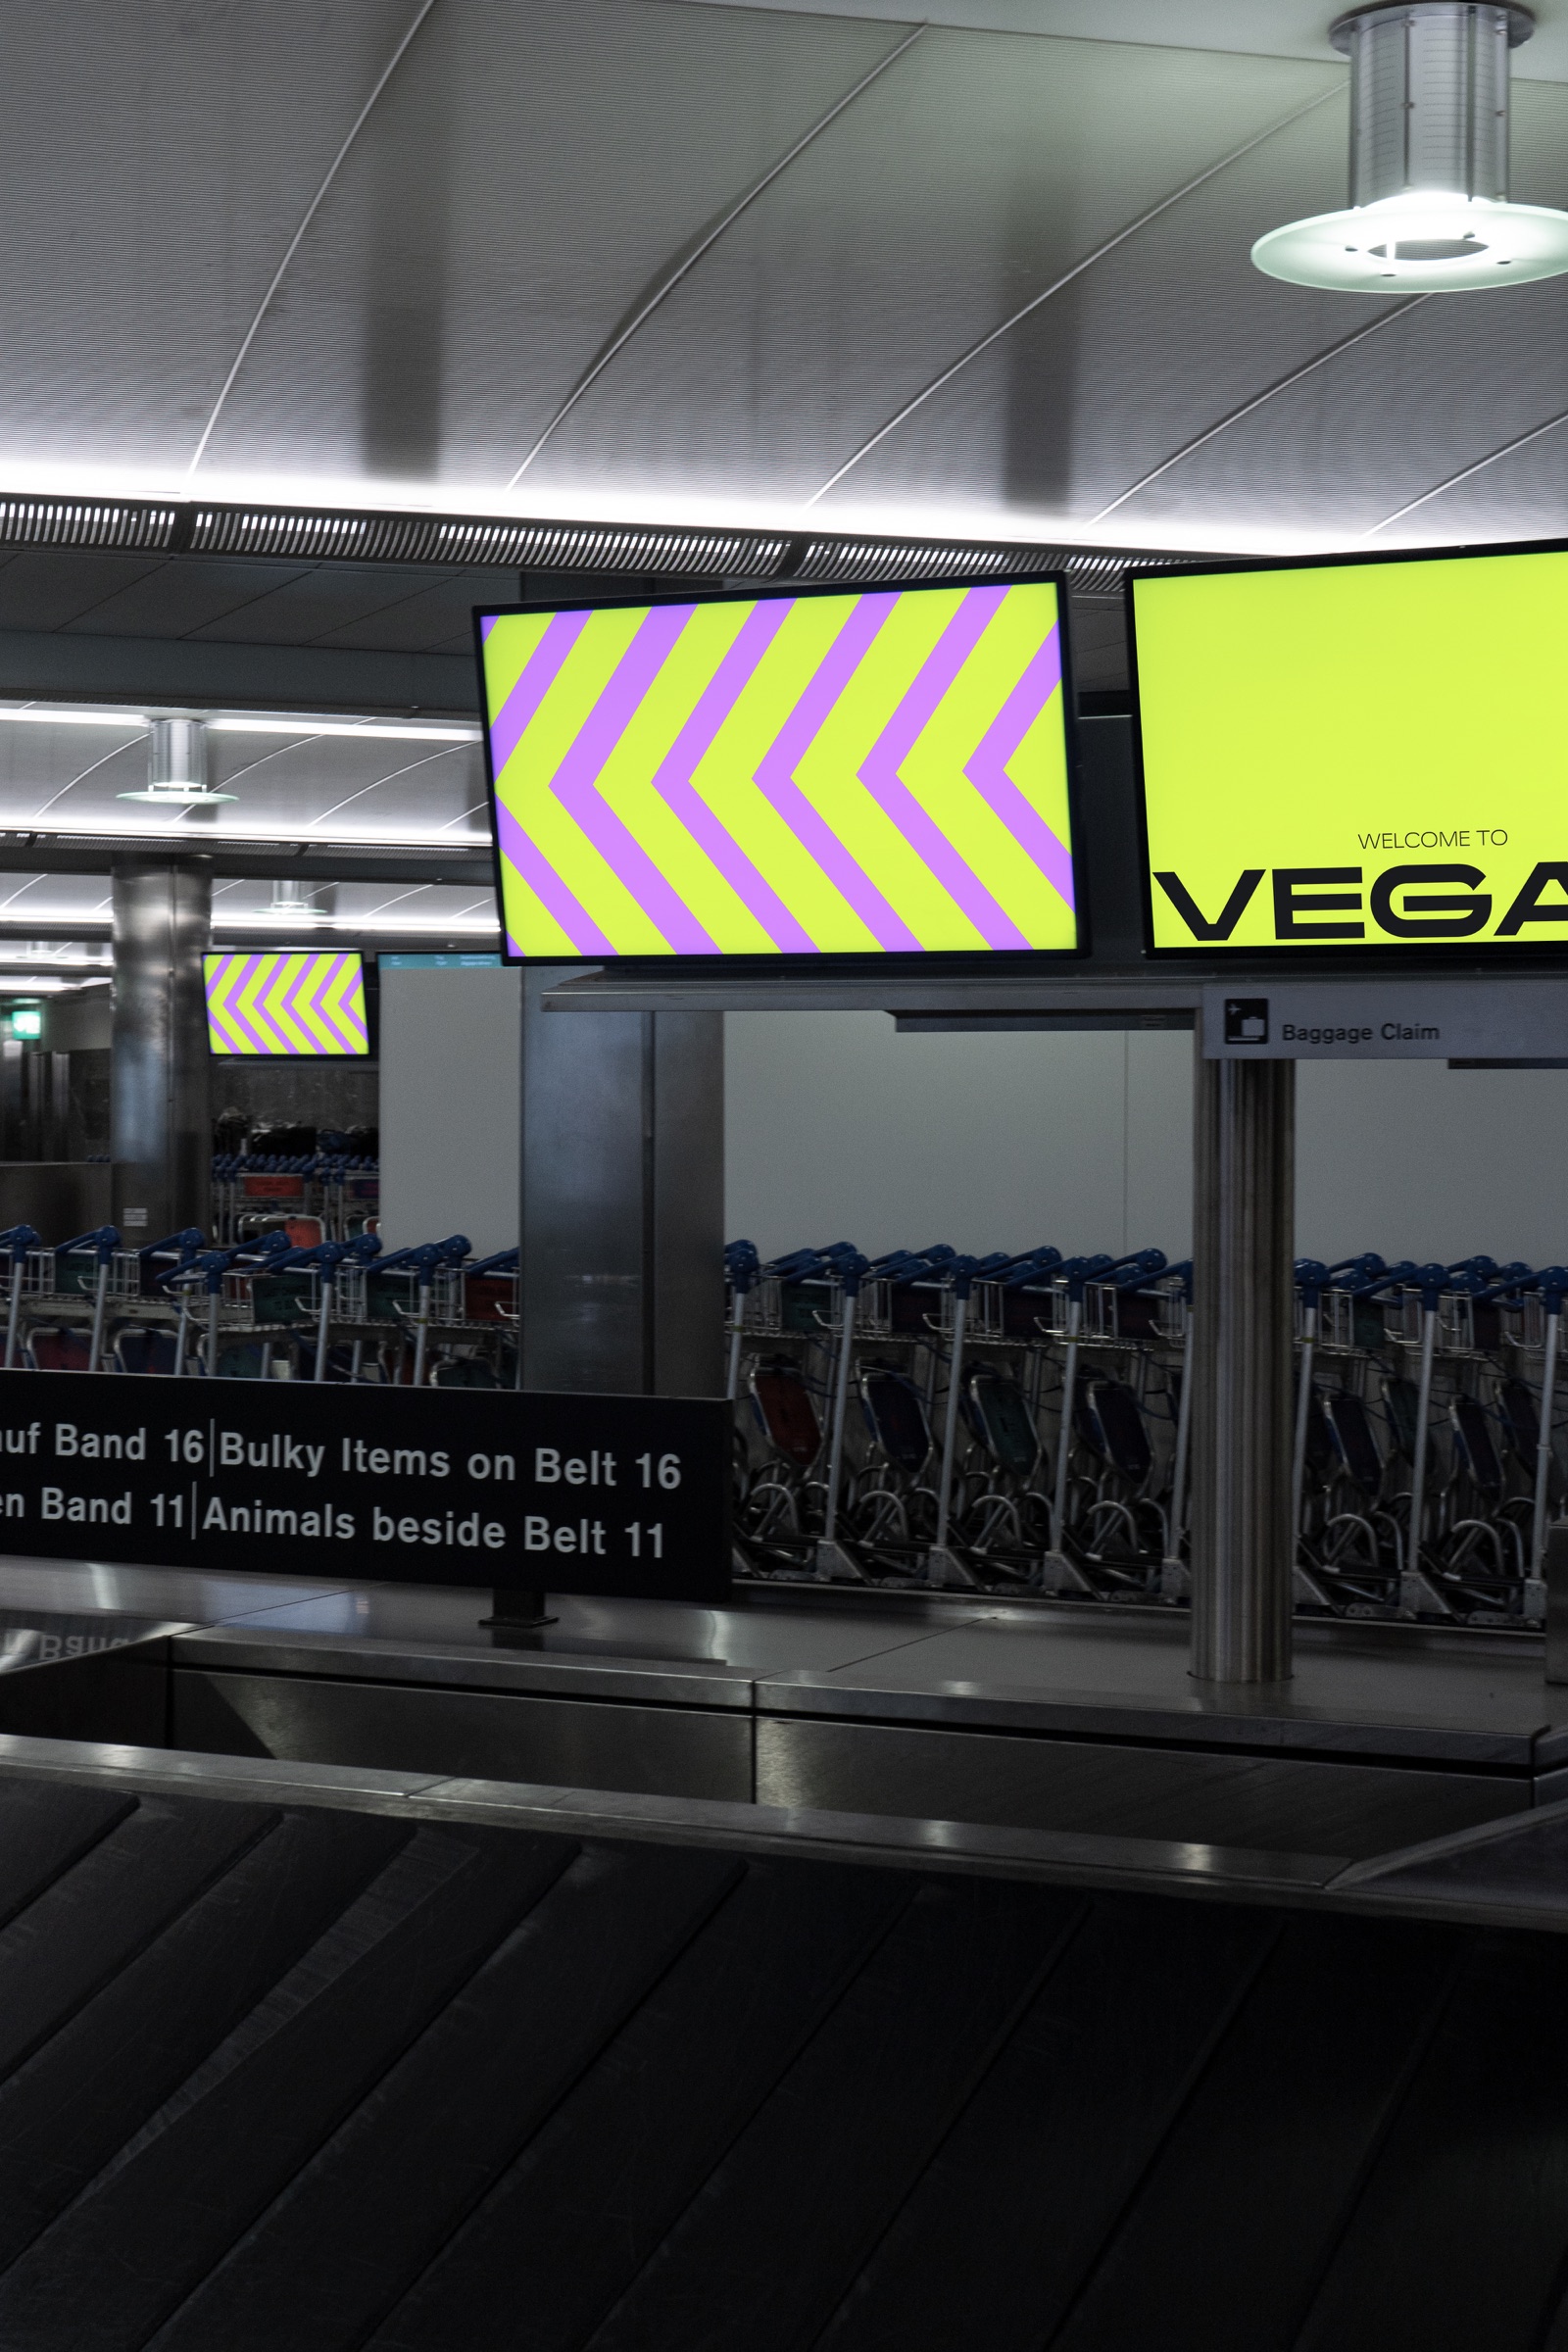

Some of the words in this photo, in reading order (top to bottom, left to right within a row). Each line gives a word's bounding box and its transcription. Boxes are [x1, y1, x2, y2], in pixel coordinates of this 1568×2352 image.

[1357, 830, 1471, 850] WELCOME
[1475, 828, 1509, 847] TO
[1152, 861, 1568, 941] VEGA
[1282, 1023, 1374, 1045] Baggage
[1380, 1022, 1441, 1042] Claim
[0, 1421, 41, 1454] uf
[55, 1423, 146, 1461] Band
[165, 1429, 205, 1464] 16
[220, 1431, 325, 1478] Bulky
[342, 1437, 450, 1478] Items
[467, 1452, 515, 1482] on
[535, 1447, 616, 1487] Belt
[635, 1452, 681, 1490] 16
[0, 1493, 24, 1518] n
[41, 1487, 132, 1525] Band
[150, 1493, 183, 1528] 11
[202, 1496, 356, 1540] Animals
[372, 1506, 506, 1548] beside
[524, 1515, 606, 1555] Belt
[624, 1521, 662, 1558] 11
